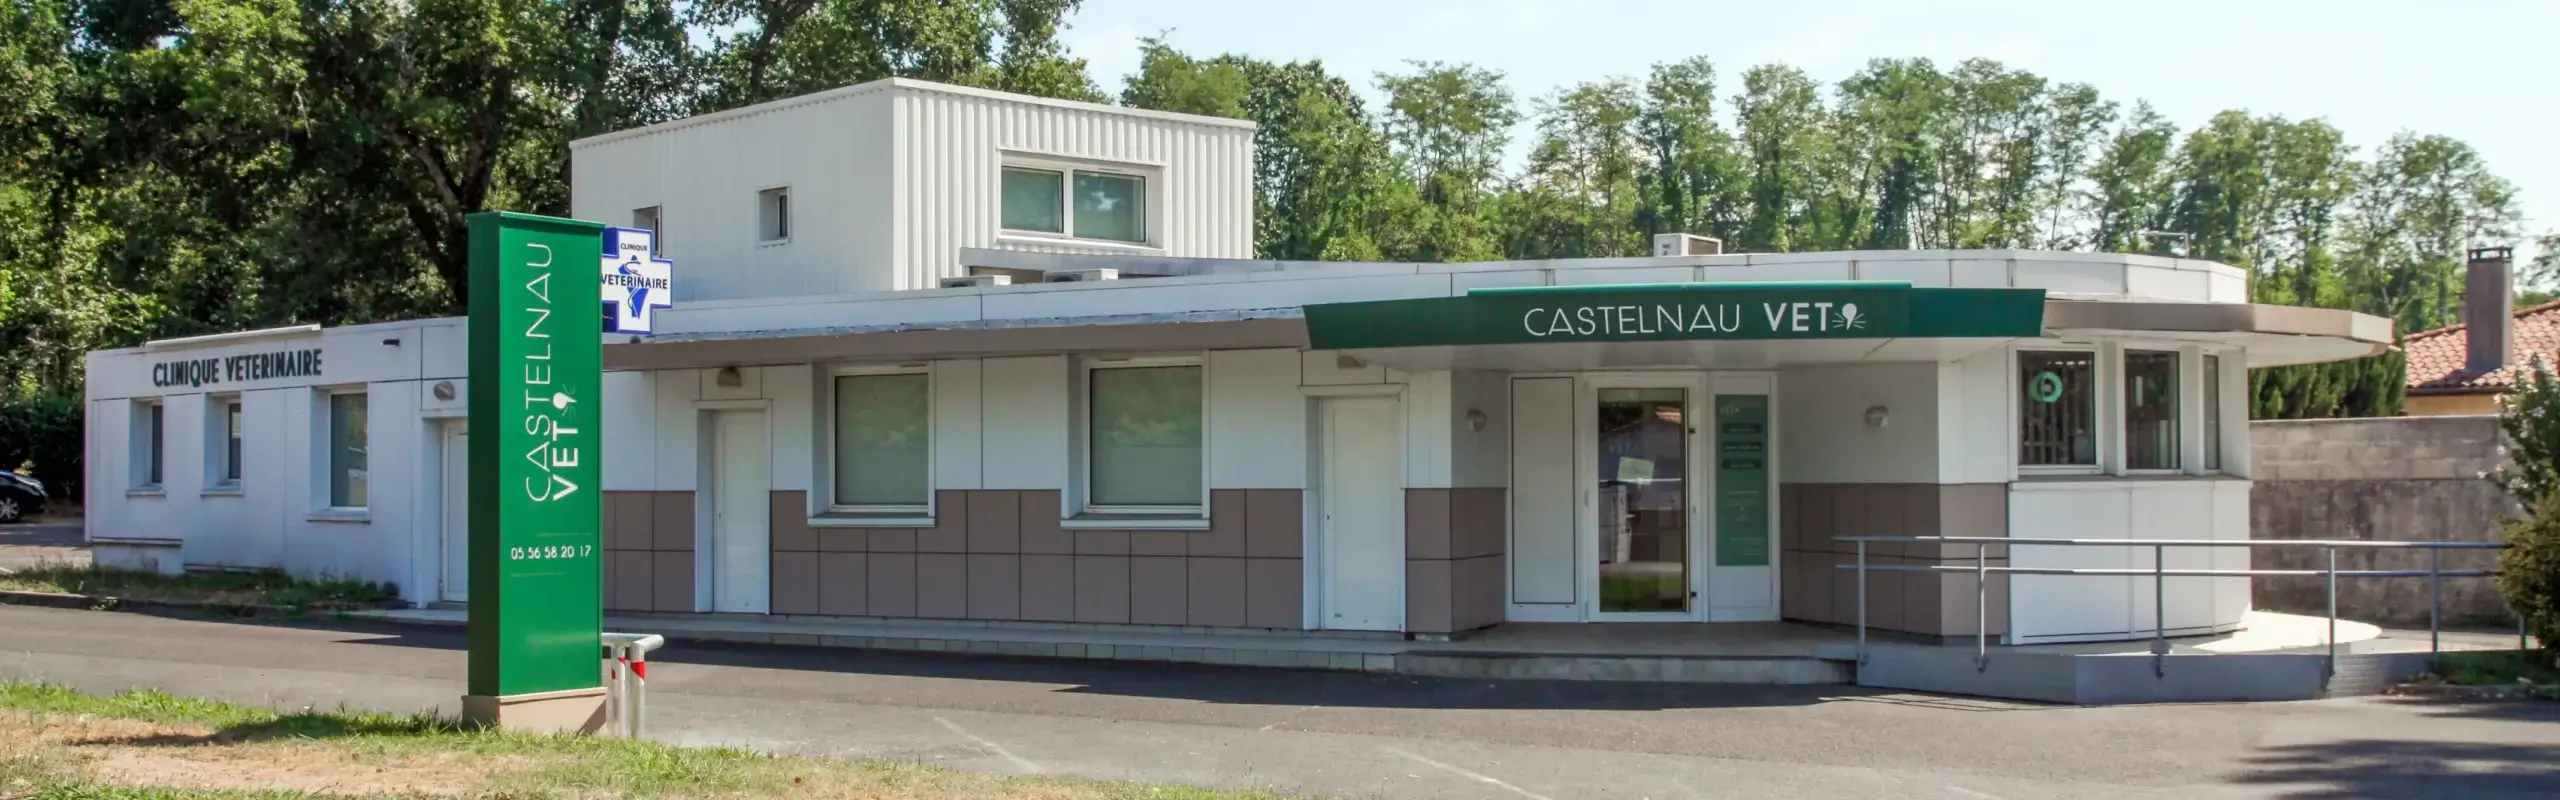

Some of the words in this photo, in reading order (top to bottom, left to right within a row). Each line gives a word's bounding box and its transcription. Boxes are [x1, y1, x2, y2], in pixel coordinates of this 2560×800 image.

[620, 242, 648, 252] CLINIQUE
[601, 273, 668, 290] VETERINAIRE
[1523, 303, 1740, 337] CASTELNAU
[153, 358, 219, 388] CLINIQUE
[225, 348, 322, 382] VETERINAIRE
[525, 243, 552, 502] CASTELNAU
[510, 546, 524, 560] 05
[527, 546, 541, 560] 56
[544, 545, 558, 559] 58
[560, 545, 575, 558] 20
[580, 544, 592, 557] 17
